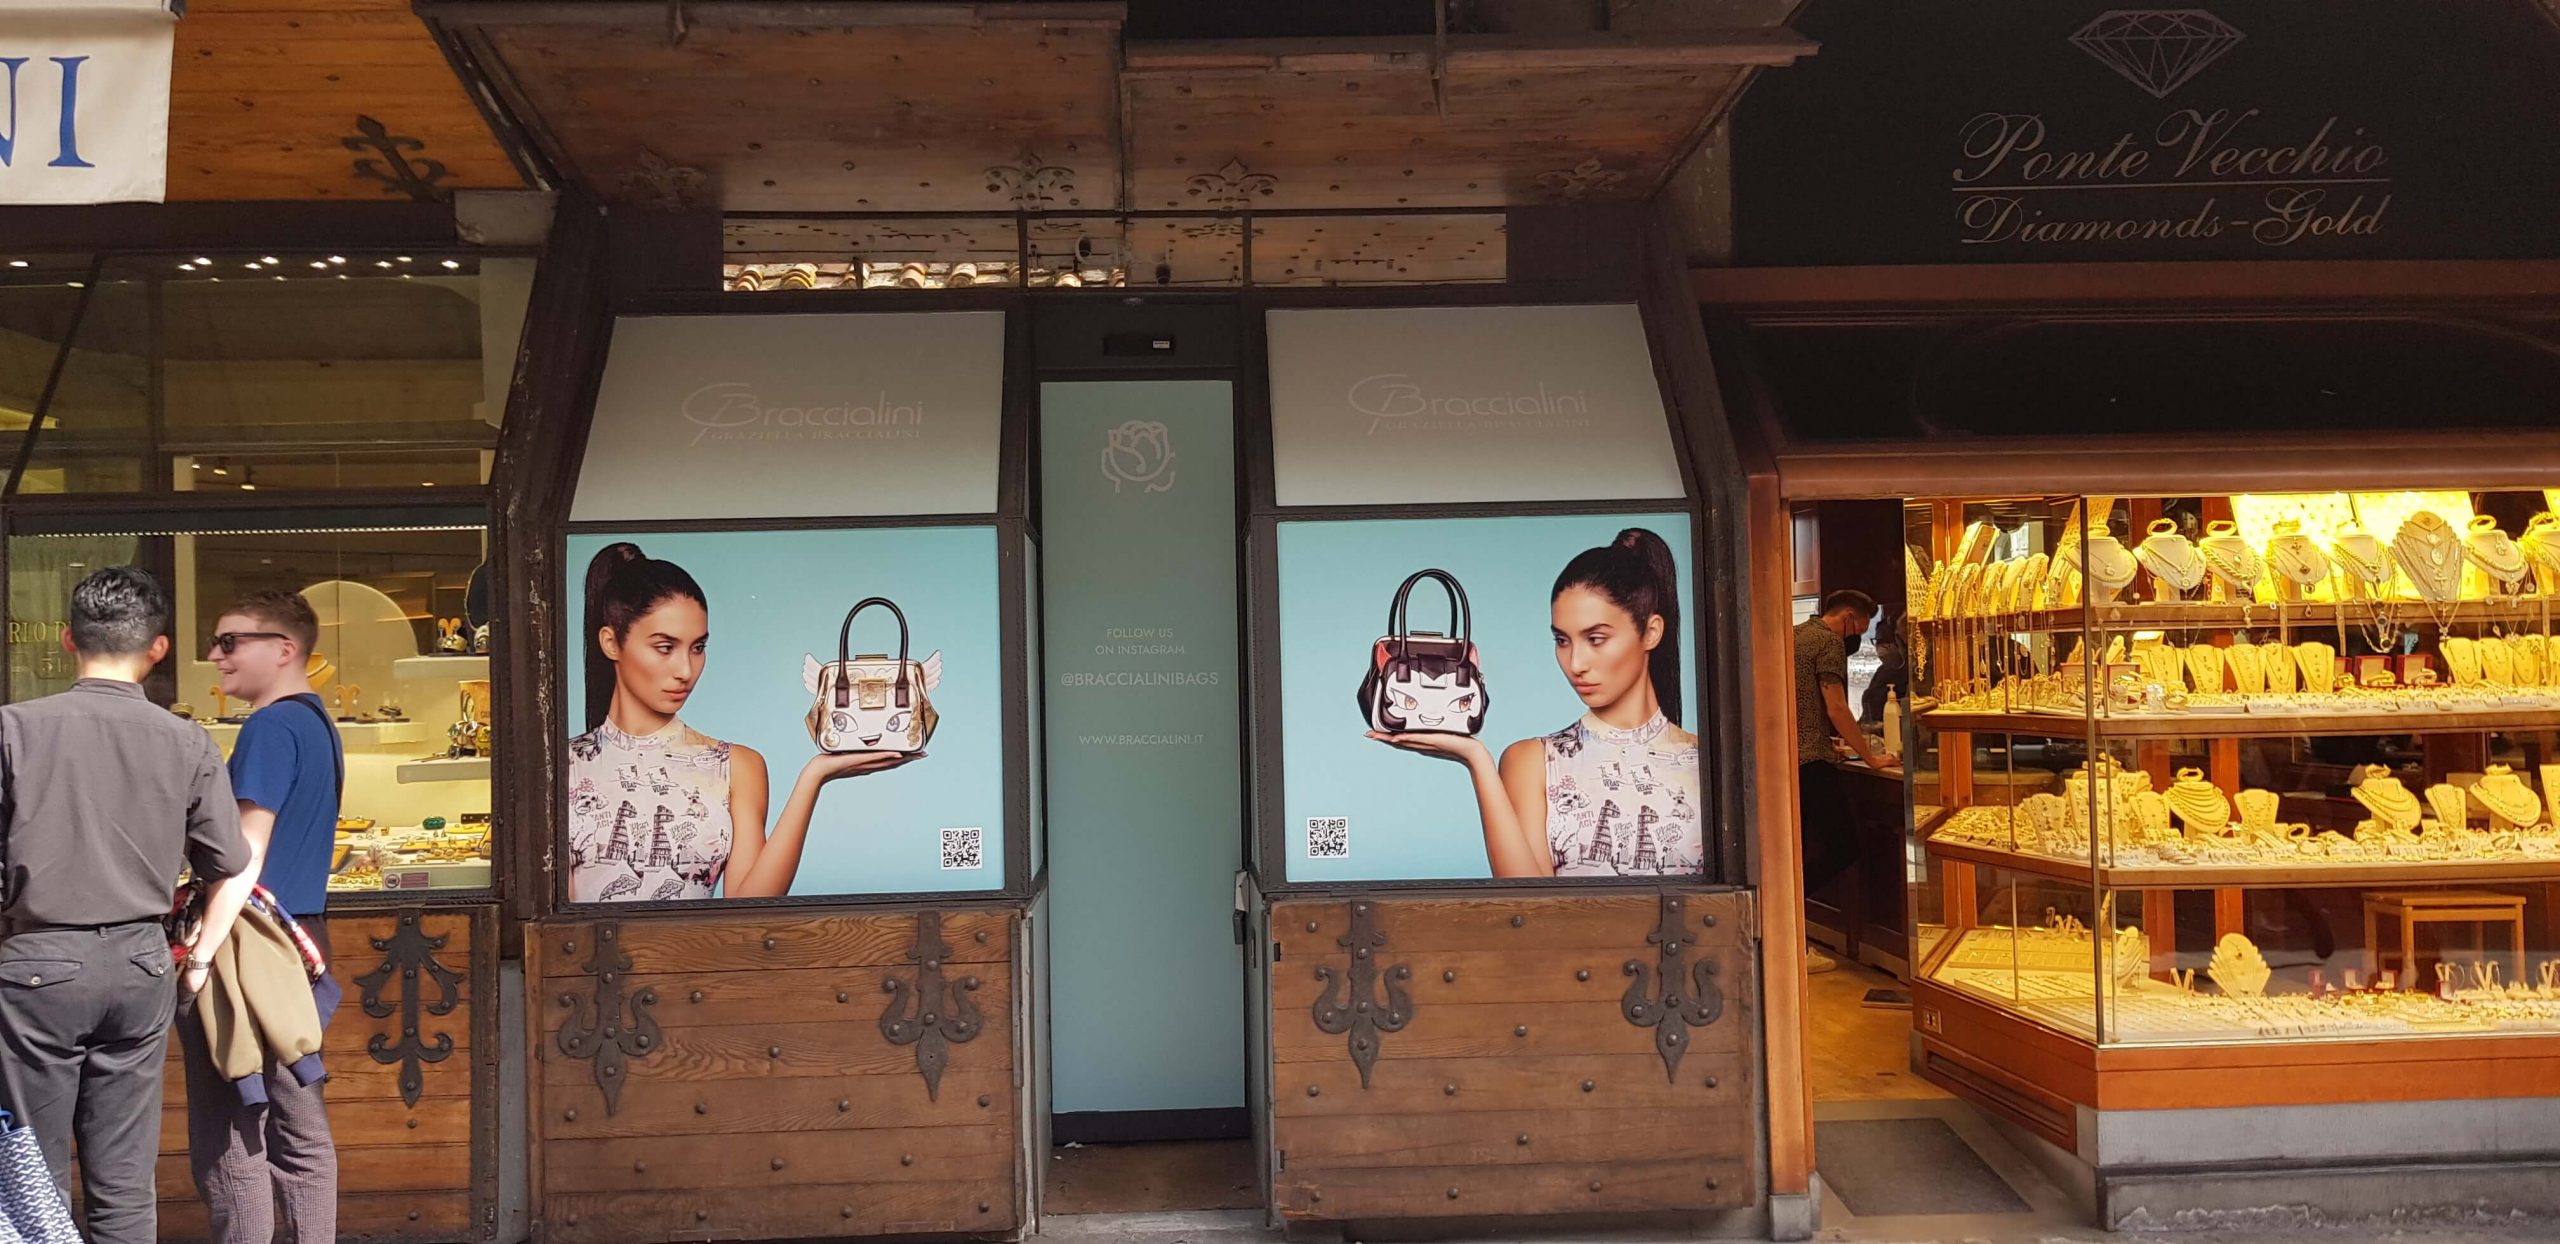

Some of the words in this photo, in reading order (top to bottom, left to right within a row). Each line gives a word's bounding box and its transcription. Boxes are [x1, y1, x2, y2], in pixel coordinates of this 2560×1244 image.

[1952, 111, 2151, 183] Ponte
[2155, 107, 2389, 180] Vecchio
[1106, 628, 1155, 639] FOLLOW
[1158, 628, 1174, 638] US
[1095, 645, 1115, 656] ON
[1118, 645, 1185, 655] INSTAGRAM
[1060, 672, 1219, 687] @BRACCIALINIBAGS
[1079, 734, 1204, 745] WWW.BRACCIALINI.IT
